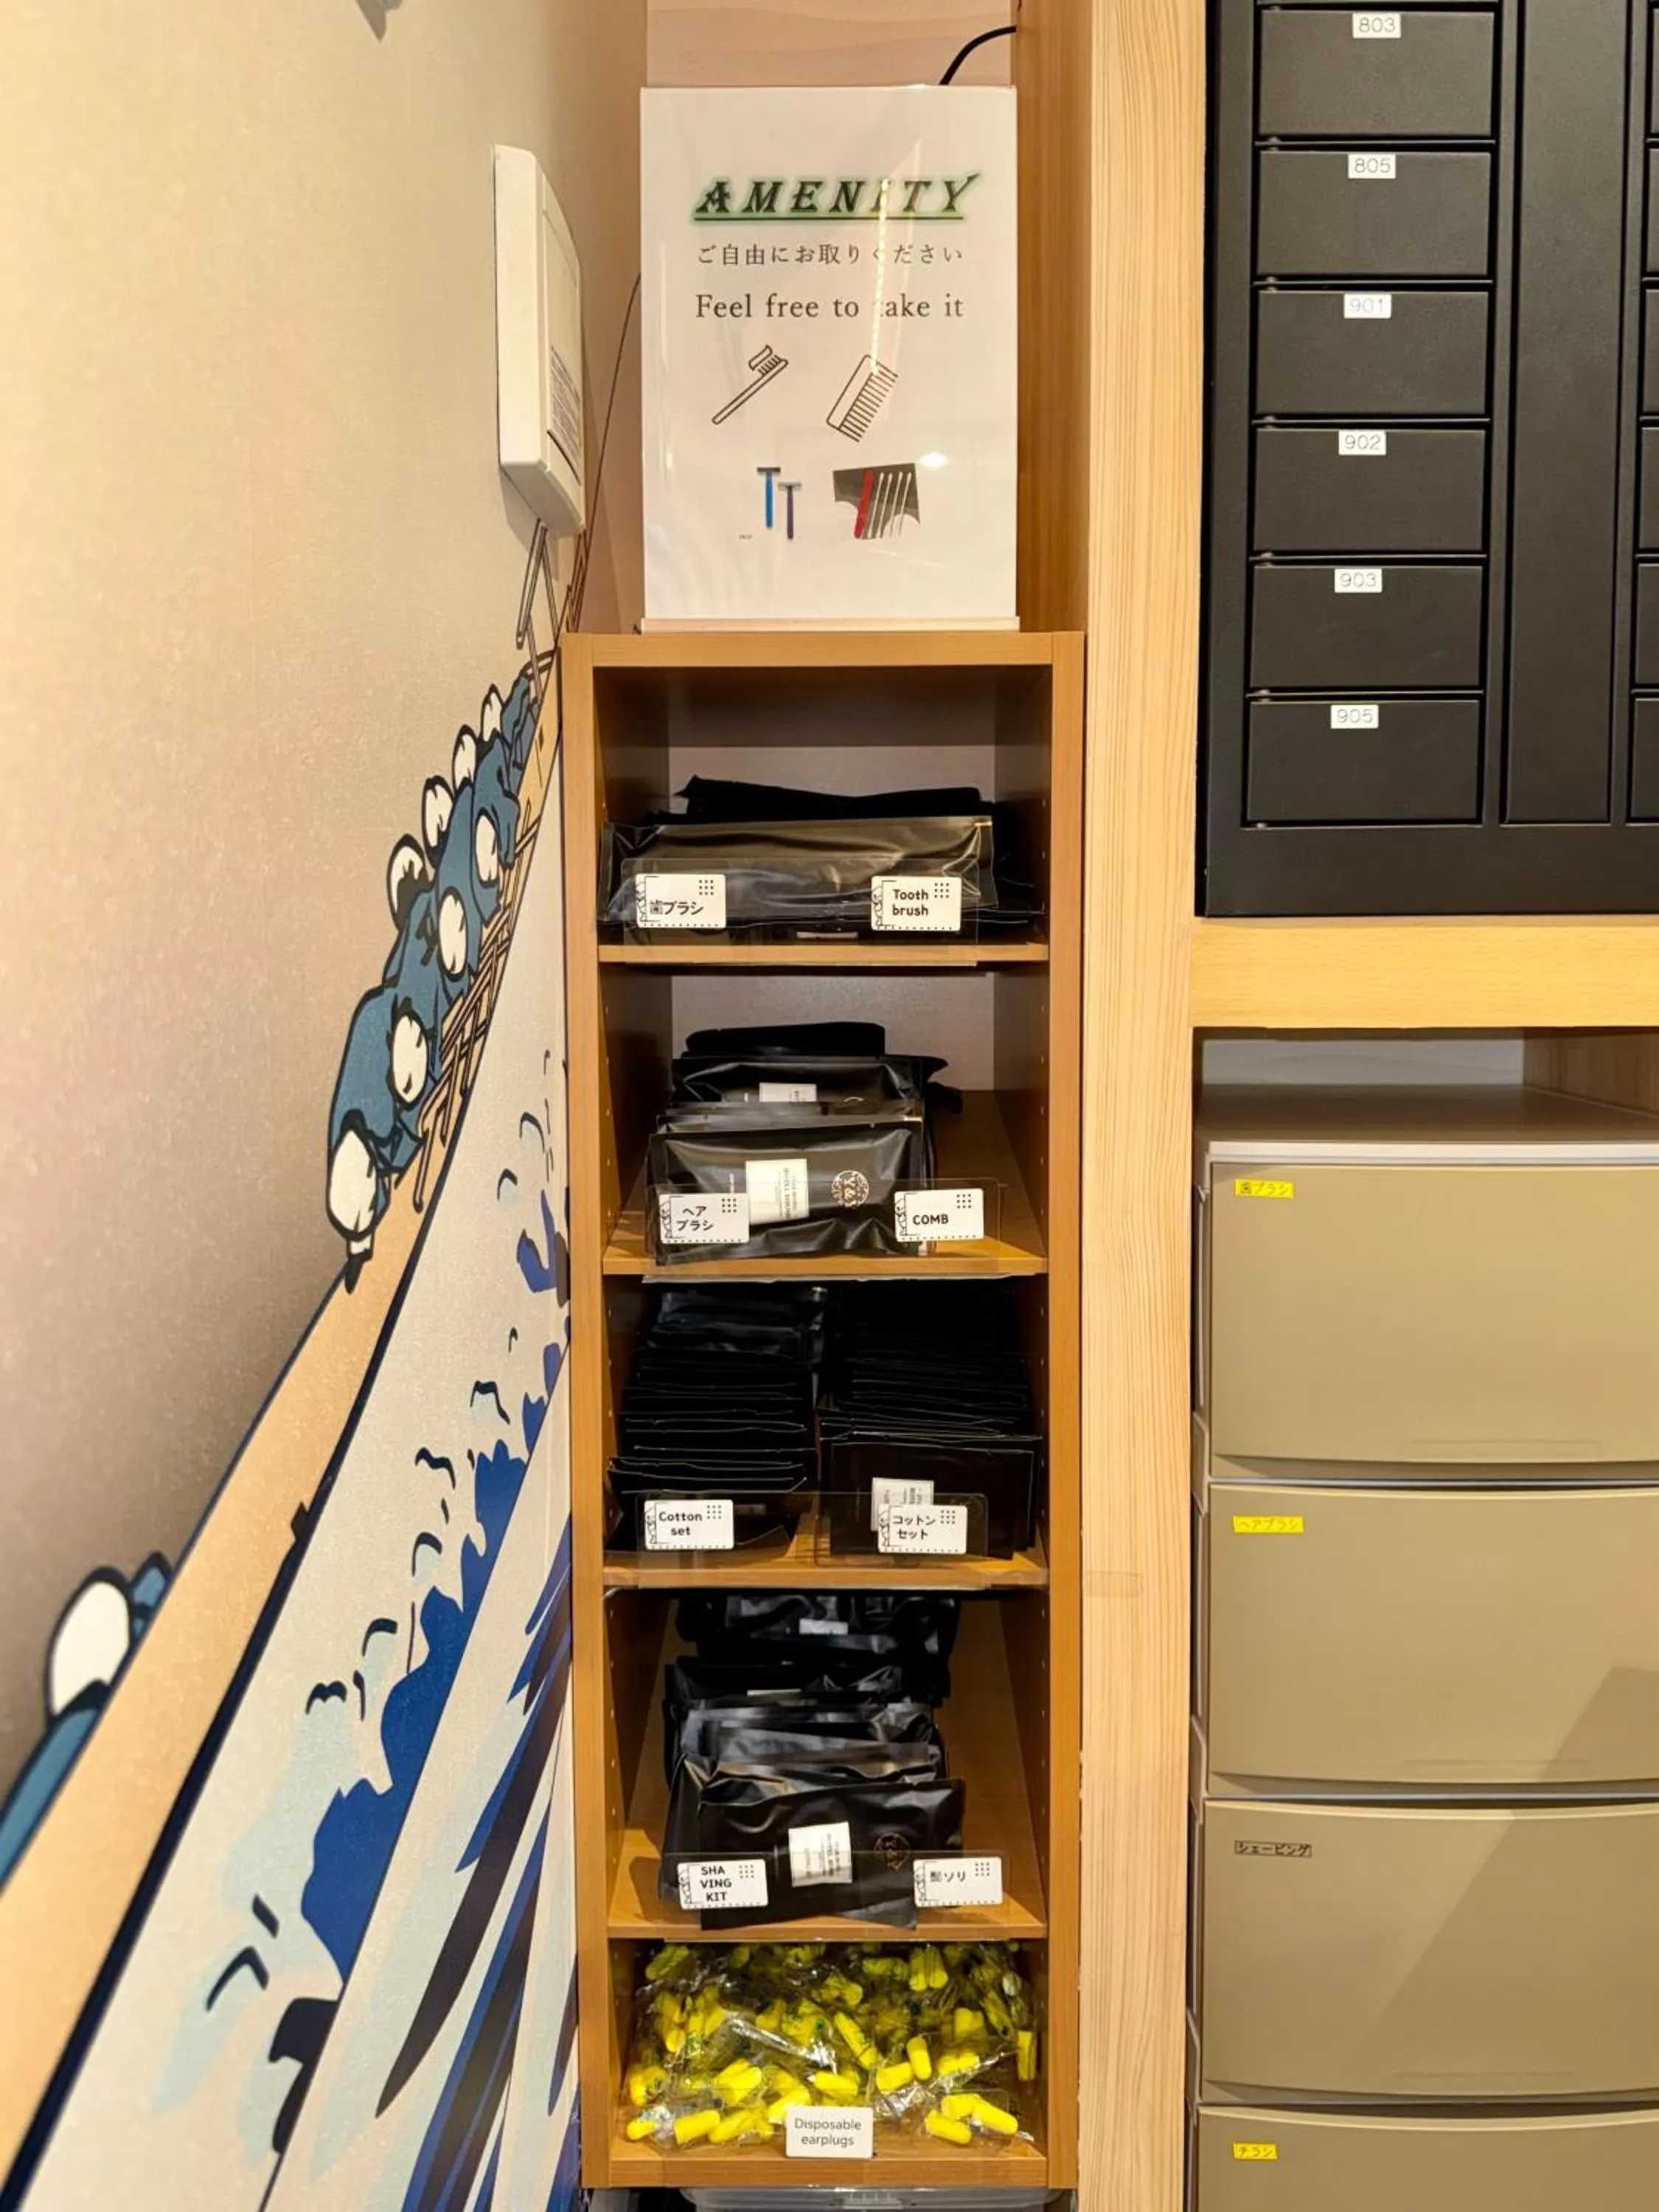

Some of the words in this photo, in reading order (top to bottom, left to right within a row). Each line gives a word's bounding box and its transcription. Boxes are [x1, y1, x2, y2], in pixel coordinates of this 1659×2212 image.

[1358, 17, 1397, 33] 803
[1354, 158, 1391, 174] 805
[695, 173, 981, 215] AMENITY
[697, 243, 963, 266] ご自由にお取りください
[695, 293, 752, 319] Feel
[765, 293, 819, 319] free
[833, 298, 860, 319] to
[876, 293, 931, 319] ake
[944, 293, 964, 319] it
[1349, 298, 1385, 313] 901
[1343, 434, 1382, 451] 902
[1340, 572, 1377, 588] 903
[1336, 709, 1374, 725] 905
[891, 888, 929, 900] Tooth
[650, 899, 704, 916] 歯ブラシ
[891, 903, 929, 916] brush
[681, 1206, 708, 1217] ヘア
[676, 1220, 716, 1231] ブラシ
[912, 1213, 950, 1225] COMB
[658, 1511, 703, 1522] Cotton
[892, 1514, 936, 1526] コットン
[669, 1526, 692, 1536] set
[897, 1528, 929, 1540] セット
[700, 1865, 726, 1876] SHA
[699, 1877, 733, 1889] VING
[705, 1891, 728, 1902] KIT
[793, 2118, 862, 2132] Disposable
[800, 2133, 855, 2148] earplugs
